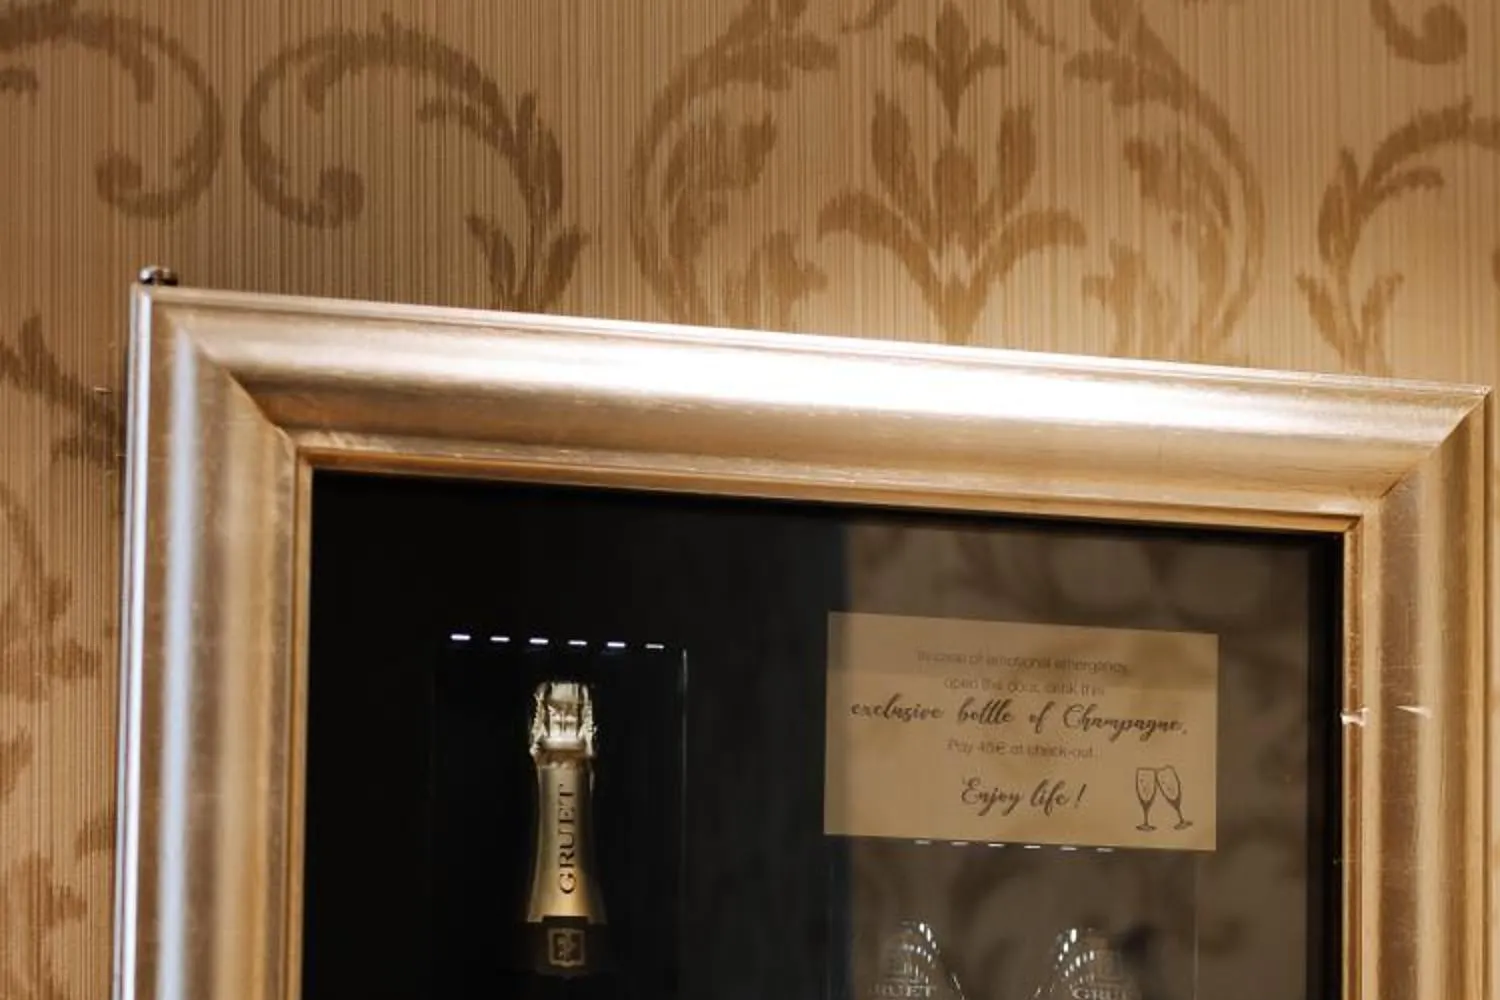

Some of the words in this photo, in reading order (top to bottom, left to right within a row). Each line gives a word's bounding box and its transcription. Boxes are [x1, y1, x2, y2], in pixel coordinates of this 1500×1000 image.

[851, 693, 944, 722] exclusive
[957, 697, 1014, 725] bottle
[1028, 701, 1055, 734] of
[947, 739, 973, 756] Pay
[961, 776, 1022, 817] Enjoy
[558, 783, 577, 894] GRUET
